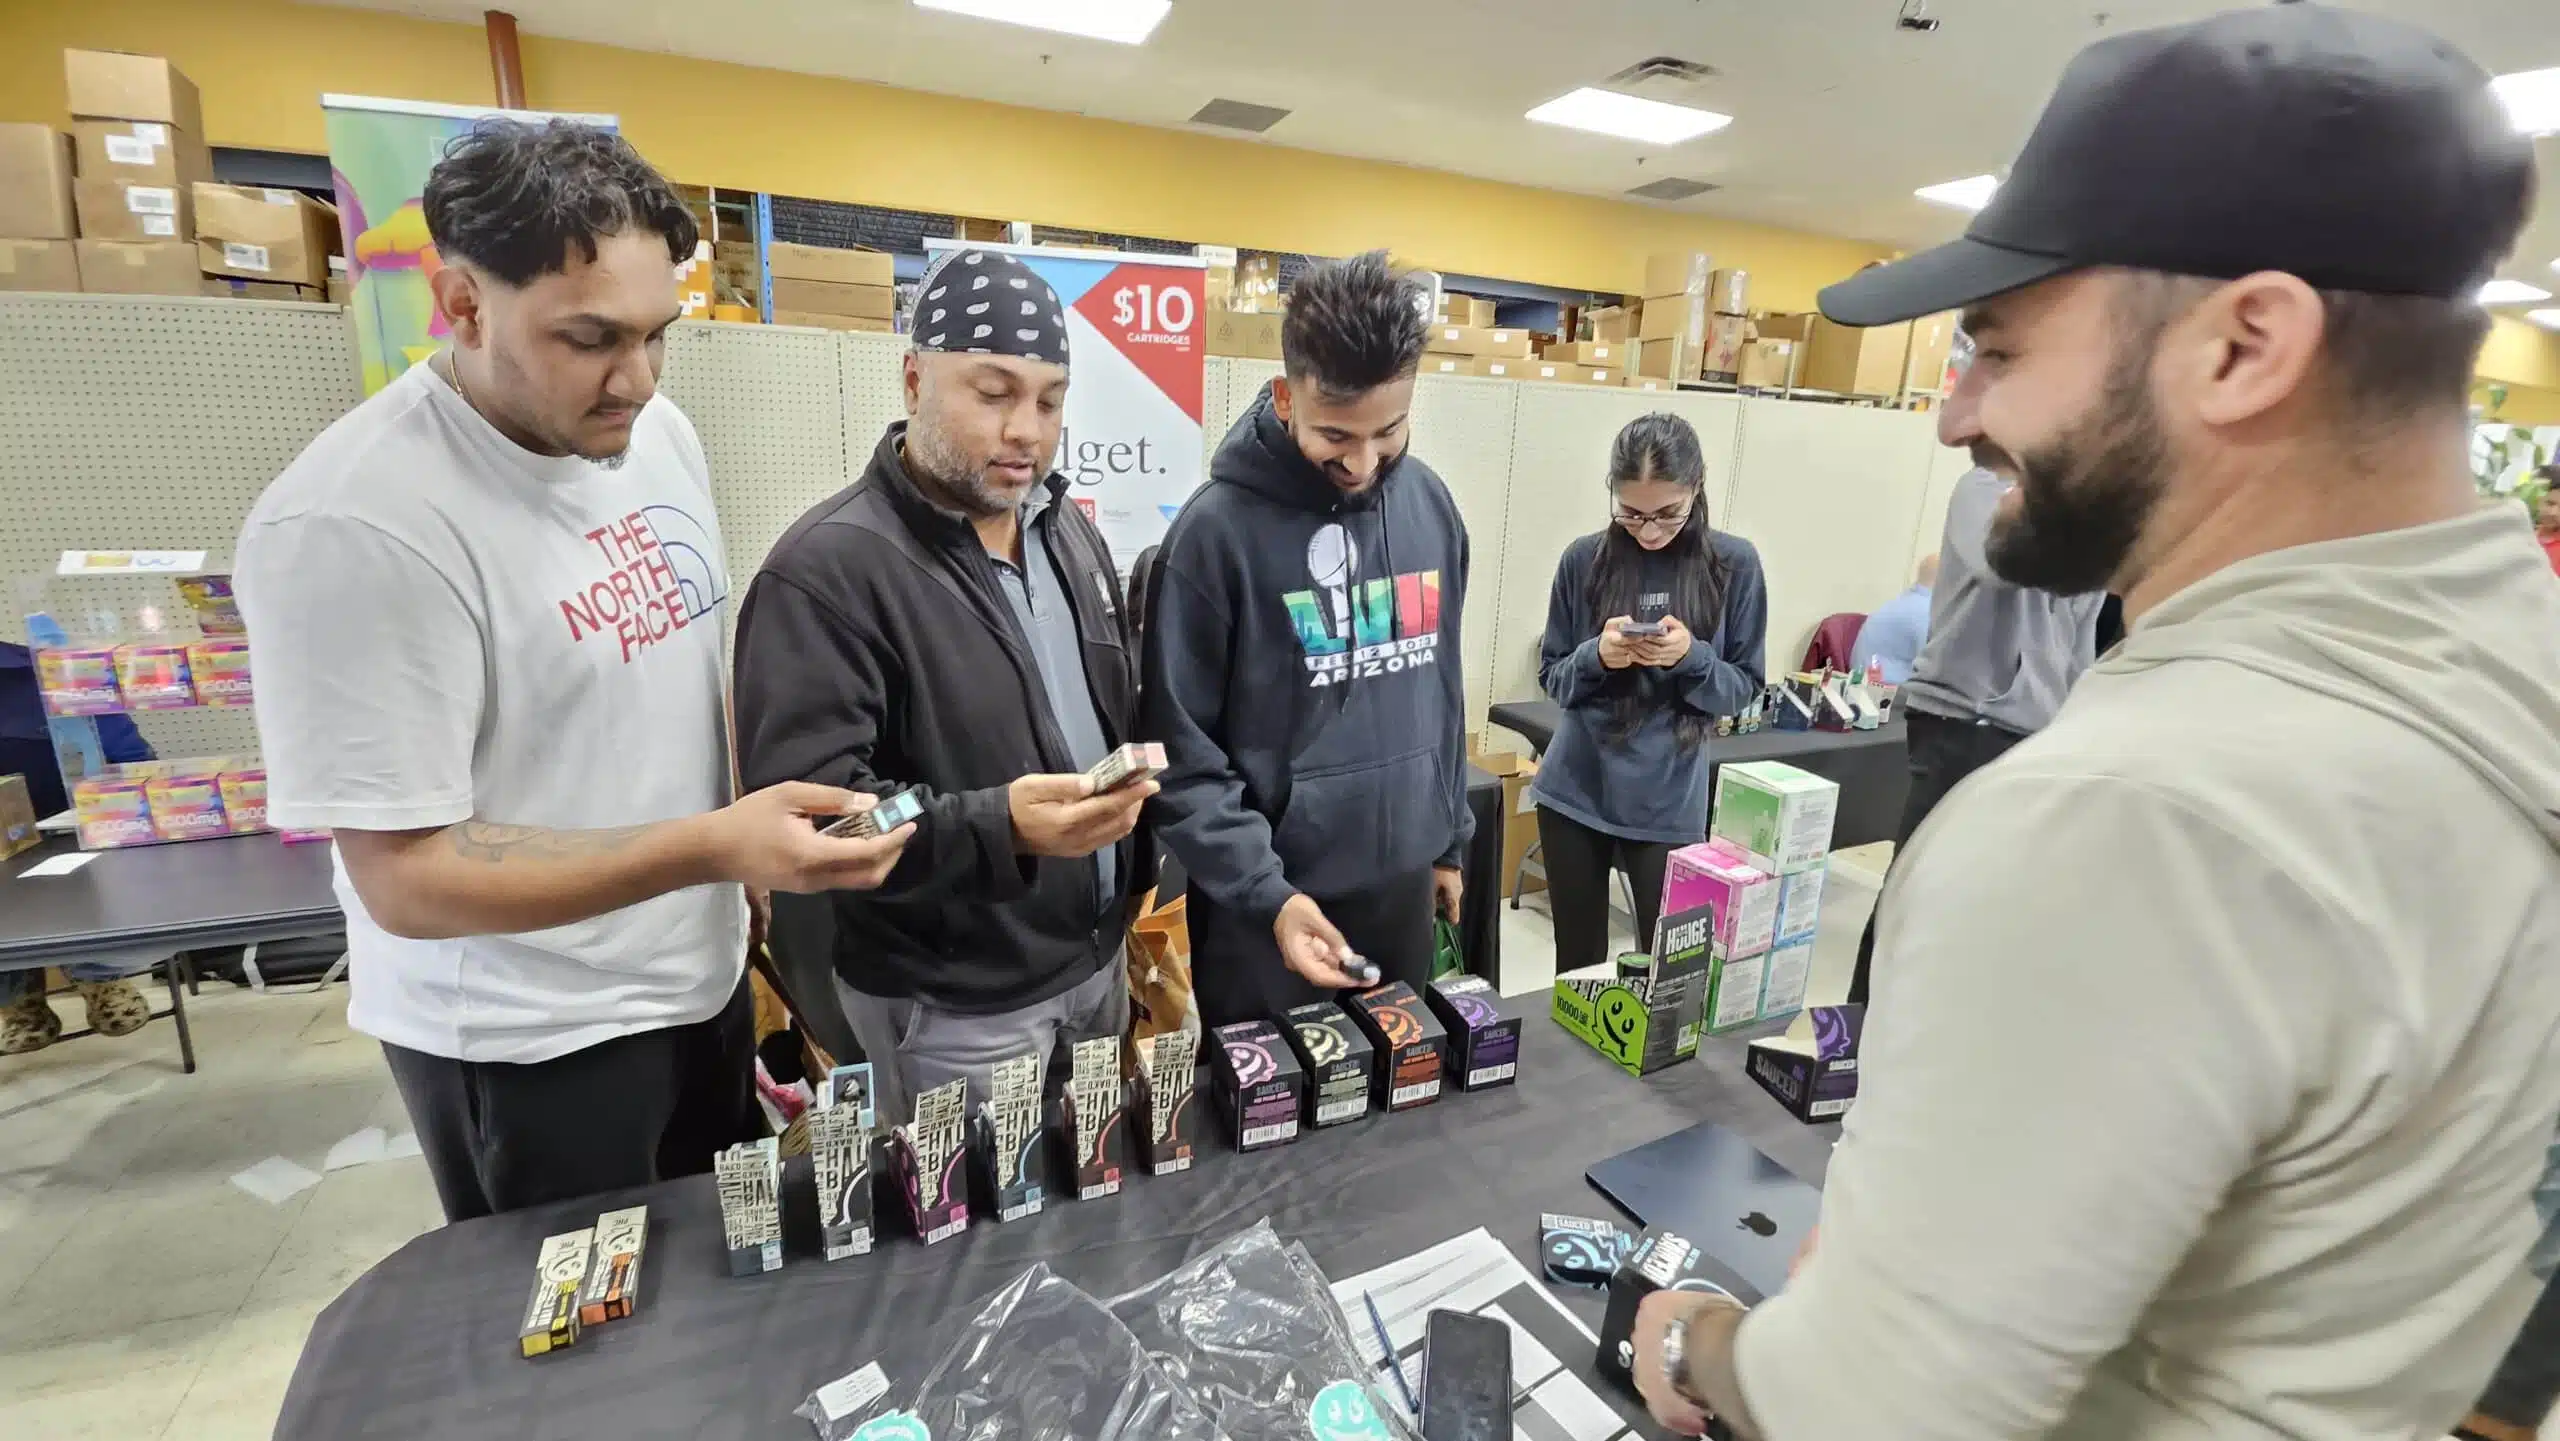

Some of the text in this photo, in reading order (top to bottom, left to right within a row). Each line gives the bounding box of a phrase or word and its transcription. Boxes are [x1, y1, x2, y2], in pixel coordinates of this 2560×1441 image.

[1112, 284, 1194, 333] $10
[1126, 332, 1190, 345] CARTRIDGES
[584, 511, 657, 568] THE
[559, 550, 675, 642] NORTH
[617, 588, 689, 664] FACE
[1310, 649, 1434, 687] ARIZONA
